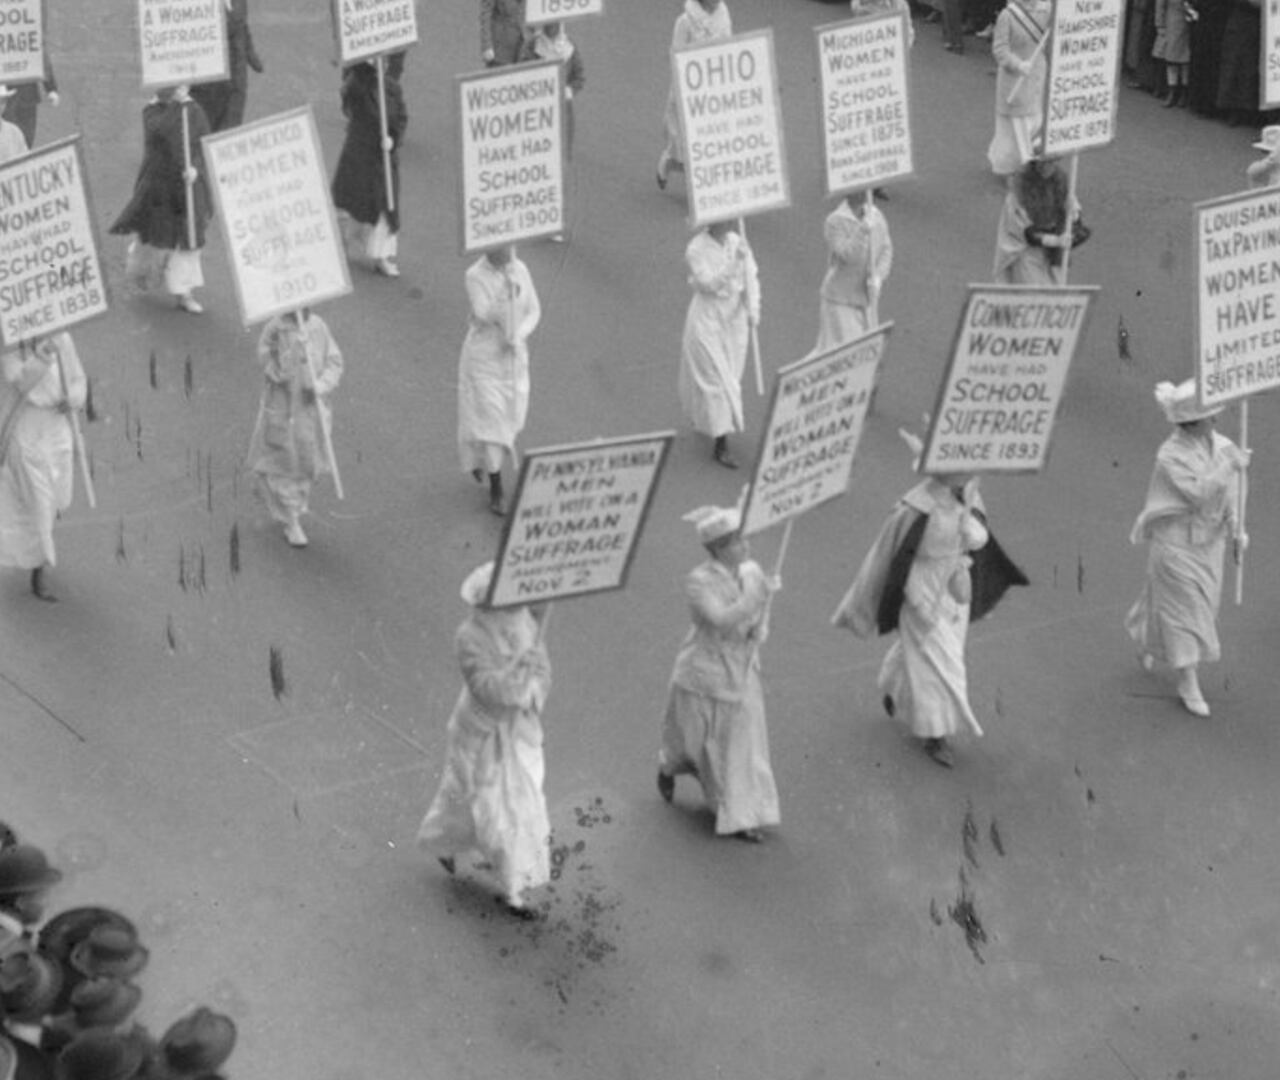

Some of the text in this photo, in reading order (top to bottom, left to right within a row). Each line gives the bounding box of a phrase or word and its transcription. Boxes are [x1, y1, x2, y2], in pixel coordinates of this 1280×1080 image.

[144, 4, 215, 25] A WOMAN
[344, 4, 411, 37] SUFFRAGE
[144, 25, 216, 48] SUFFRAGE
[823, 25, 898, 52] MICHIGAN
[1060, 37, 1108, 56] WOMEN
[686, 50, 756, 90] OHIO
[829, 46, 895, 73] WOMEN
[467, 79, 555, 111] WISCONSIN
[687, 87, 763, 119] WOMEN
[828, 82, 898, 110] SCHOOL
[469, 106, 554, 142] WOMEN
[828, 101, 903, 134] SUFFRAGE
[479, 138, 552, 166] HAVE HAD
[691, 134, 771, 161] SCHOOL
[479, 164, 552, 193] SCHOOL
[694, 152, 775, 189] SUFFRAGE
[470, 186, 557, 220] SUFFRAGE
[234, 200, 321, 240] SCHOOL
[472, 206, 559, 240] SINCE 1900
[0, 257, 96, 313] SUFFRAGE
[8, 290, 101, 337] SINCE 1838
[970, 299, 1082, 329] CONNECTICUT
[1216, 293, 1277, 334] HAVE
[968, 332, 1062, 357] WOMEN
[1015, 362, 1047, 375] HAD
[800, 379, 848, 407] MEN
[951, 378, 1051, 403] SCHOOL
[940, 407, 1049, 436] SUFFRAGE
[774, 415, 853, 460] WOMAN
[937, 442, 1039, 461] SINCE 1893
[557, 476, 616, 495] MEN
[524, 514, 621, 541] WOMAN
[508, 532, 626, 567] SUFFRAGE
[518, 578, 563, 595] NOV
